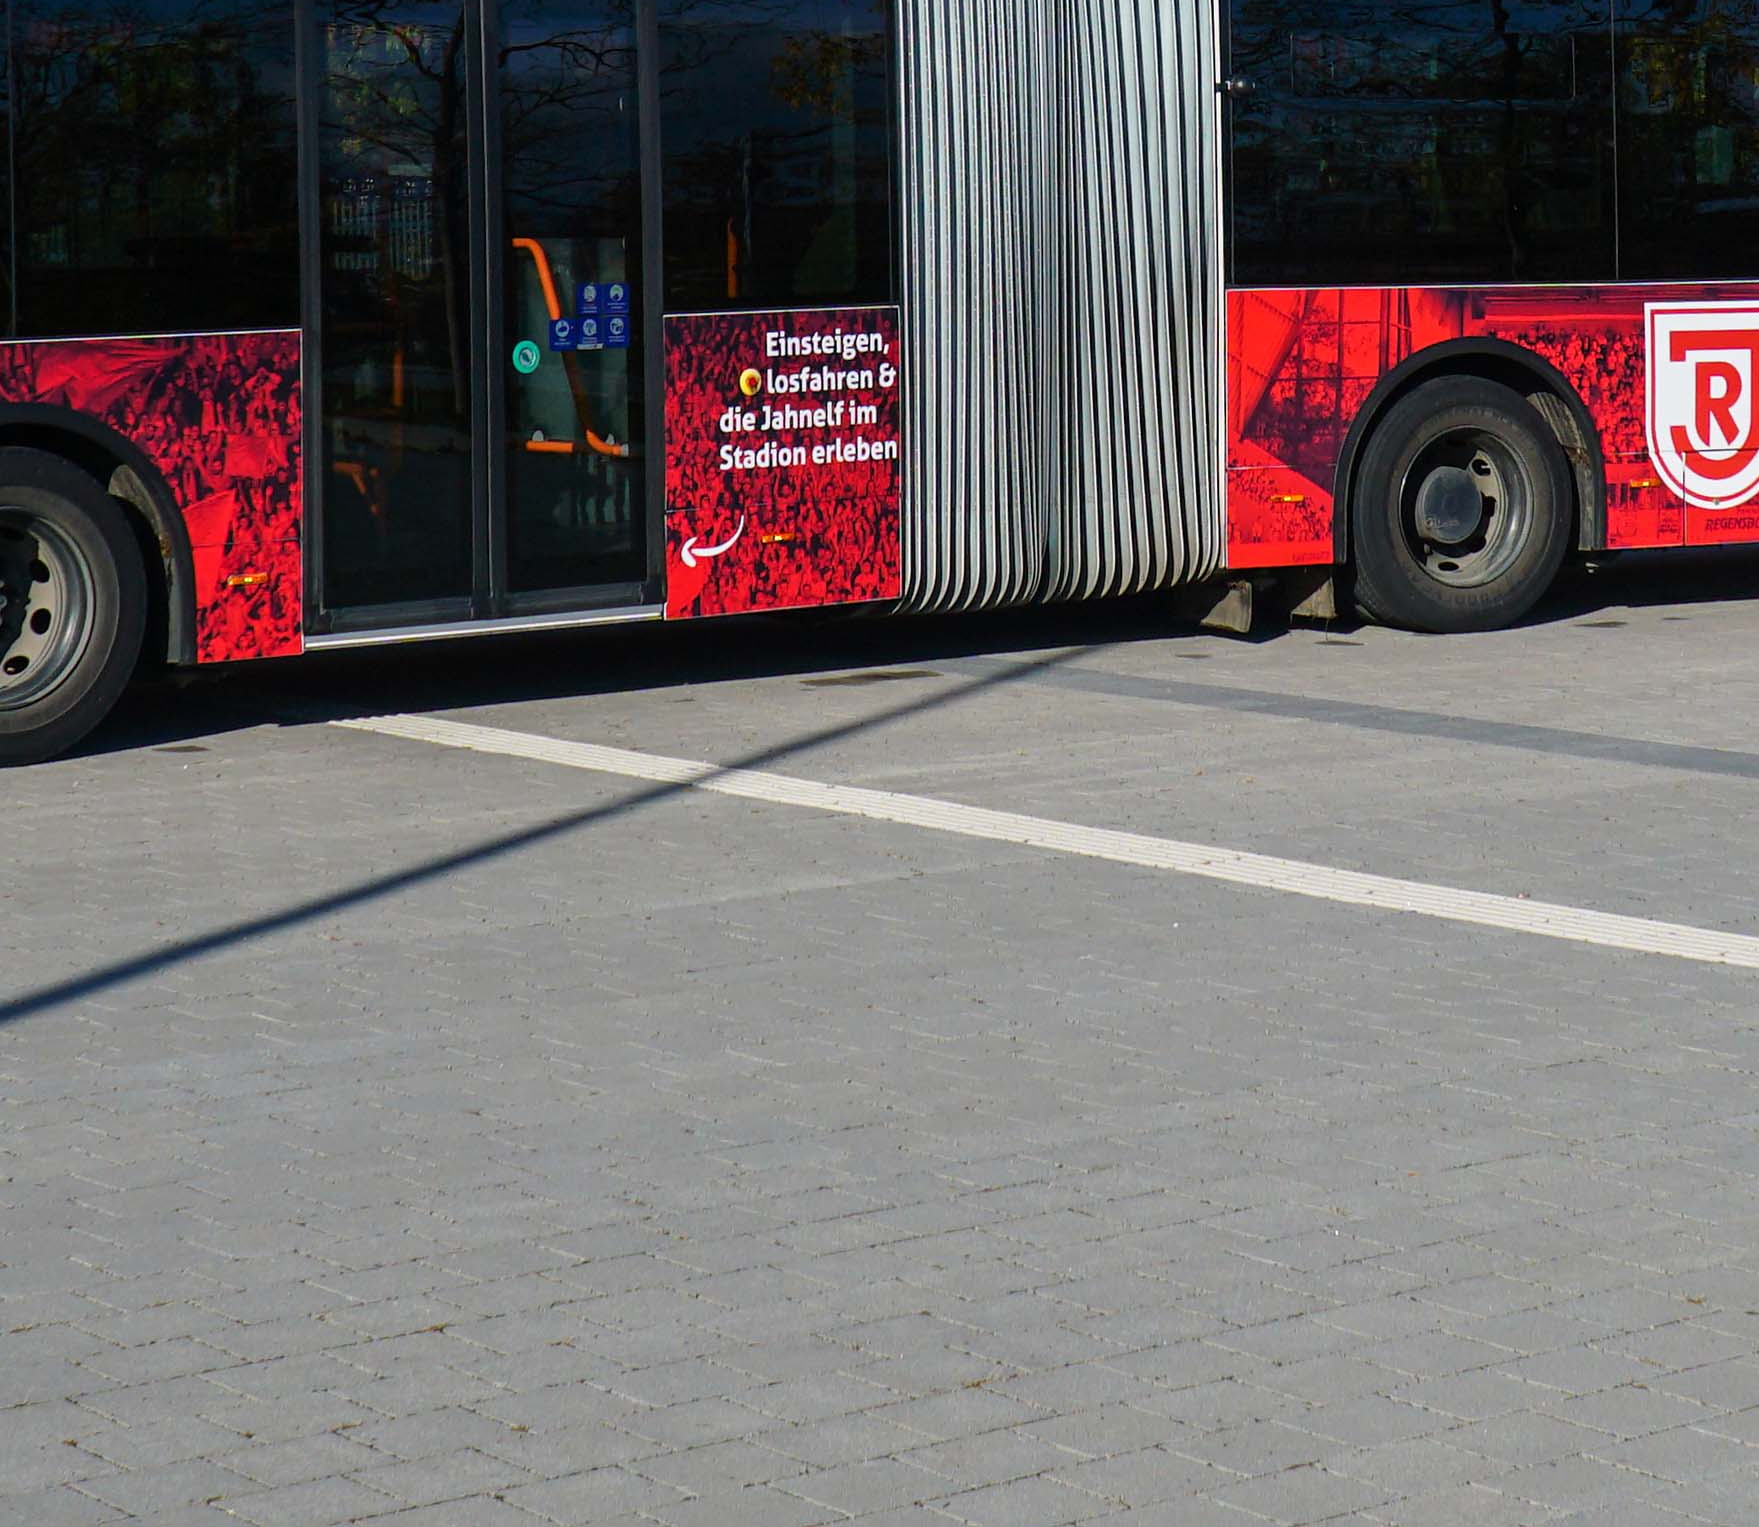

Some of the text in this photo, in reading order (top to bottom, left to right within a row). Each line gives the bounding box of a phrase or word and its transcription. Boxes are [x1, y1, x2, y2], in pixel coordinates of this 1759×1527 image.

[766, 328, 890, 360] Einsteigen,
[767, 362, 897, 394] losfahren &
[719, 399, 878, 433] die Jahnelf im
[719, 435, 898, 470] Stadion erleben
